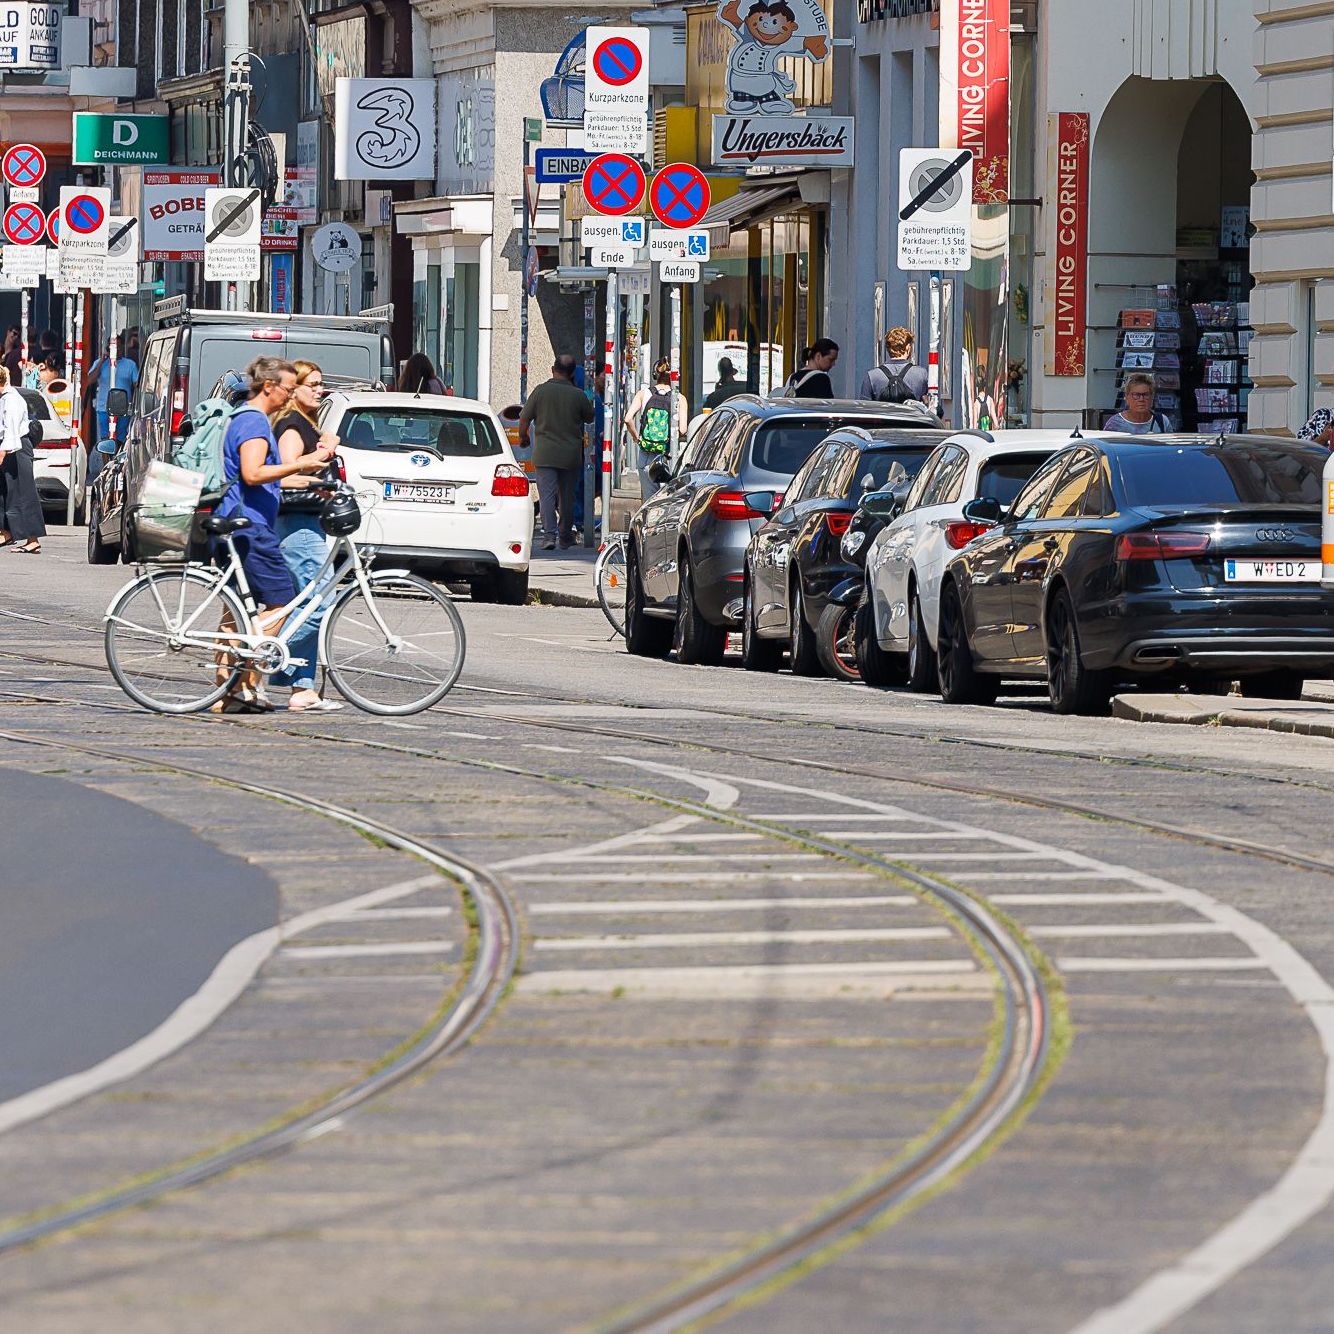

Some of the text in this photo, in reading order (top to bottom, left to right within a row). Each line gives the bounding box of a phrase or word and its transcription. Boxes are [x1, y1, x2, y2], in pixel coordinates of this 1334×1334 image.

[30, 8, 59, 28] GOLD
[30, 29, 58, 42] ANKAUF
[589, 92, 644, 104] Kurzparkzone
[958, 84, 985, 159] LIVING
[94, 150, 158, 159] DEICHMANN
[168, 223, 205, 233] GETRÄ
[584, 226, 621, 239] ausgen.
[904, 227, 966, 236] gebührenpflichtig
[61, 238, 105, 248] Kurzparkzone
[902, 237, 940, 245] Parkdauer:
[942, 237, 951, 246] 1,5
[1058, 141, 1078, 337] LIVING CORNER
[651, 240, 687, 252] ausgen.
[601, 252, 625, 263] Ende
[664, 266, 695, 278] Anfang
[393, 484, 401, 495] W
[1253, 563, 1265, 577] W
